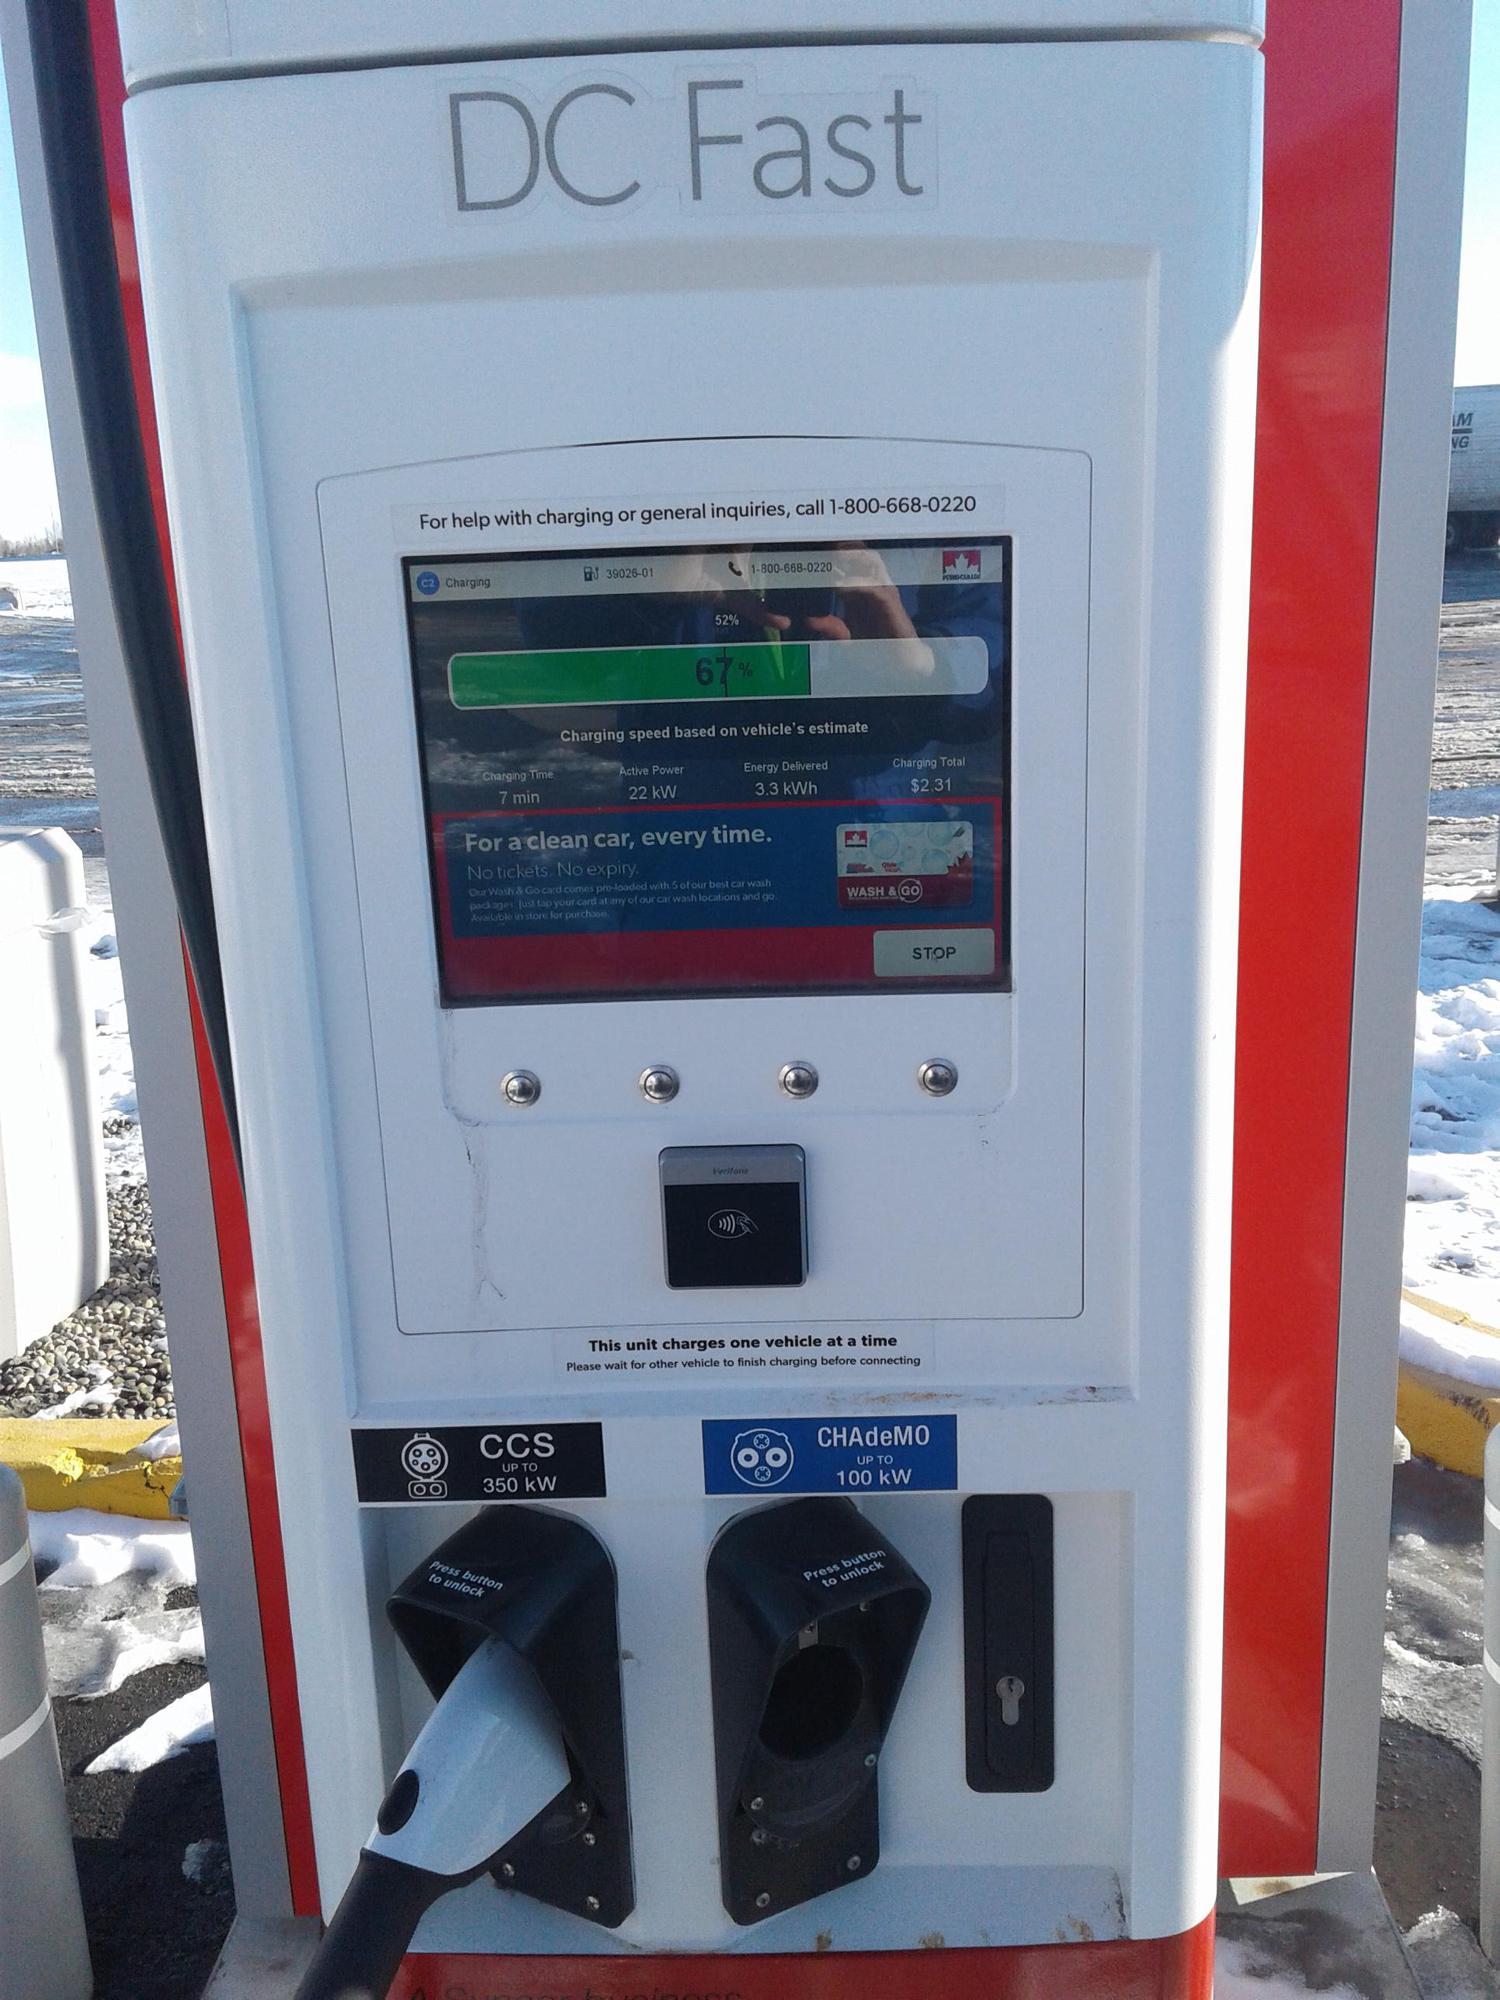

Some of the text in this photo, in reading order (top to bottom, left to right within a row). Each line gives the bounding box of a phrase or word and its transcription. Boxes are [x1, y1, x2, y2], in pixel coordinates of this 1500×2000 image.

[449, 79, 924, 212] DC Fast
[420, 496, 976, 530] For help with charging or general inquiries, call 1-800-668-0220
[606, 567, 654, 579] 39026-01
[751, 562, 832, 574] 1-800-668-0220
[445, 576, 491, 589] Charging
[715, 614, 739, 626] 52%
[560, 721, 869, 743] Charging speed based on vehicle's estimate
[744, 760, 828, 774] Energy Delivered
[893, 756, 965, 769] Charging Total
[482, 769, 553, 782] Charging Time
[619, 765, 684, 777] Active Power
[629, 785, 677, 800] 22 kW
[755, 780, 818, 795] 3.3 kWh
[910, 777, 951, 793] $2.31
[499, 790, 540, 804] 7 min
[465, 825, 772, 852] For a clean car, every time.
[467, 861, 639, 880] No tickets. No expiry.
[649, 882, 669, 890] with
[680, 881, 690, 889] of
[709, 881, 729, 889] best
[731, 880, 745, 888] car
[747, 879, 771, 887] wash
[847, 885, 920, 897] WASH & GO
[912, 946, 956, 960] STOP
[589, 1334, 897, 1352] This unit charges one vehicle at a time
[566, 1356, 921, 1372] Please wait for other vehicle to finish charging before connecting
[817, 1424, 930, 1447] CHAdeMO
[479, 1432, 555, 1459] CCS
[857, 1455, 894, 1465] UP TO
[502, 1463, 538, 1473] UP TO
[483, 1476, 557, 1493] 350 kW
[837, 1469, 912, 1486] 100 kW
[803, 1549, 886, 1581] Press button
[429, 1560, 503, 1591] Press button
[822, 1561, 885, 1588] to unlock
[428, 1573, 485, 1598] to unlock
